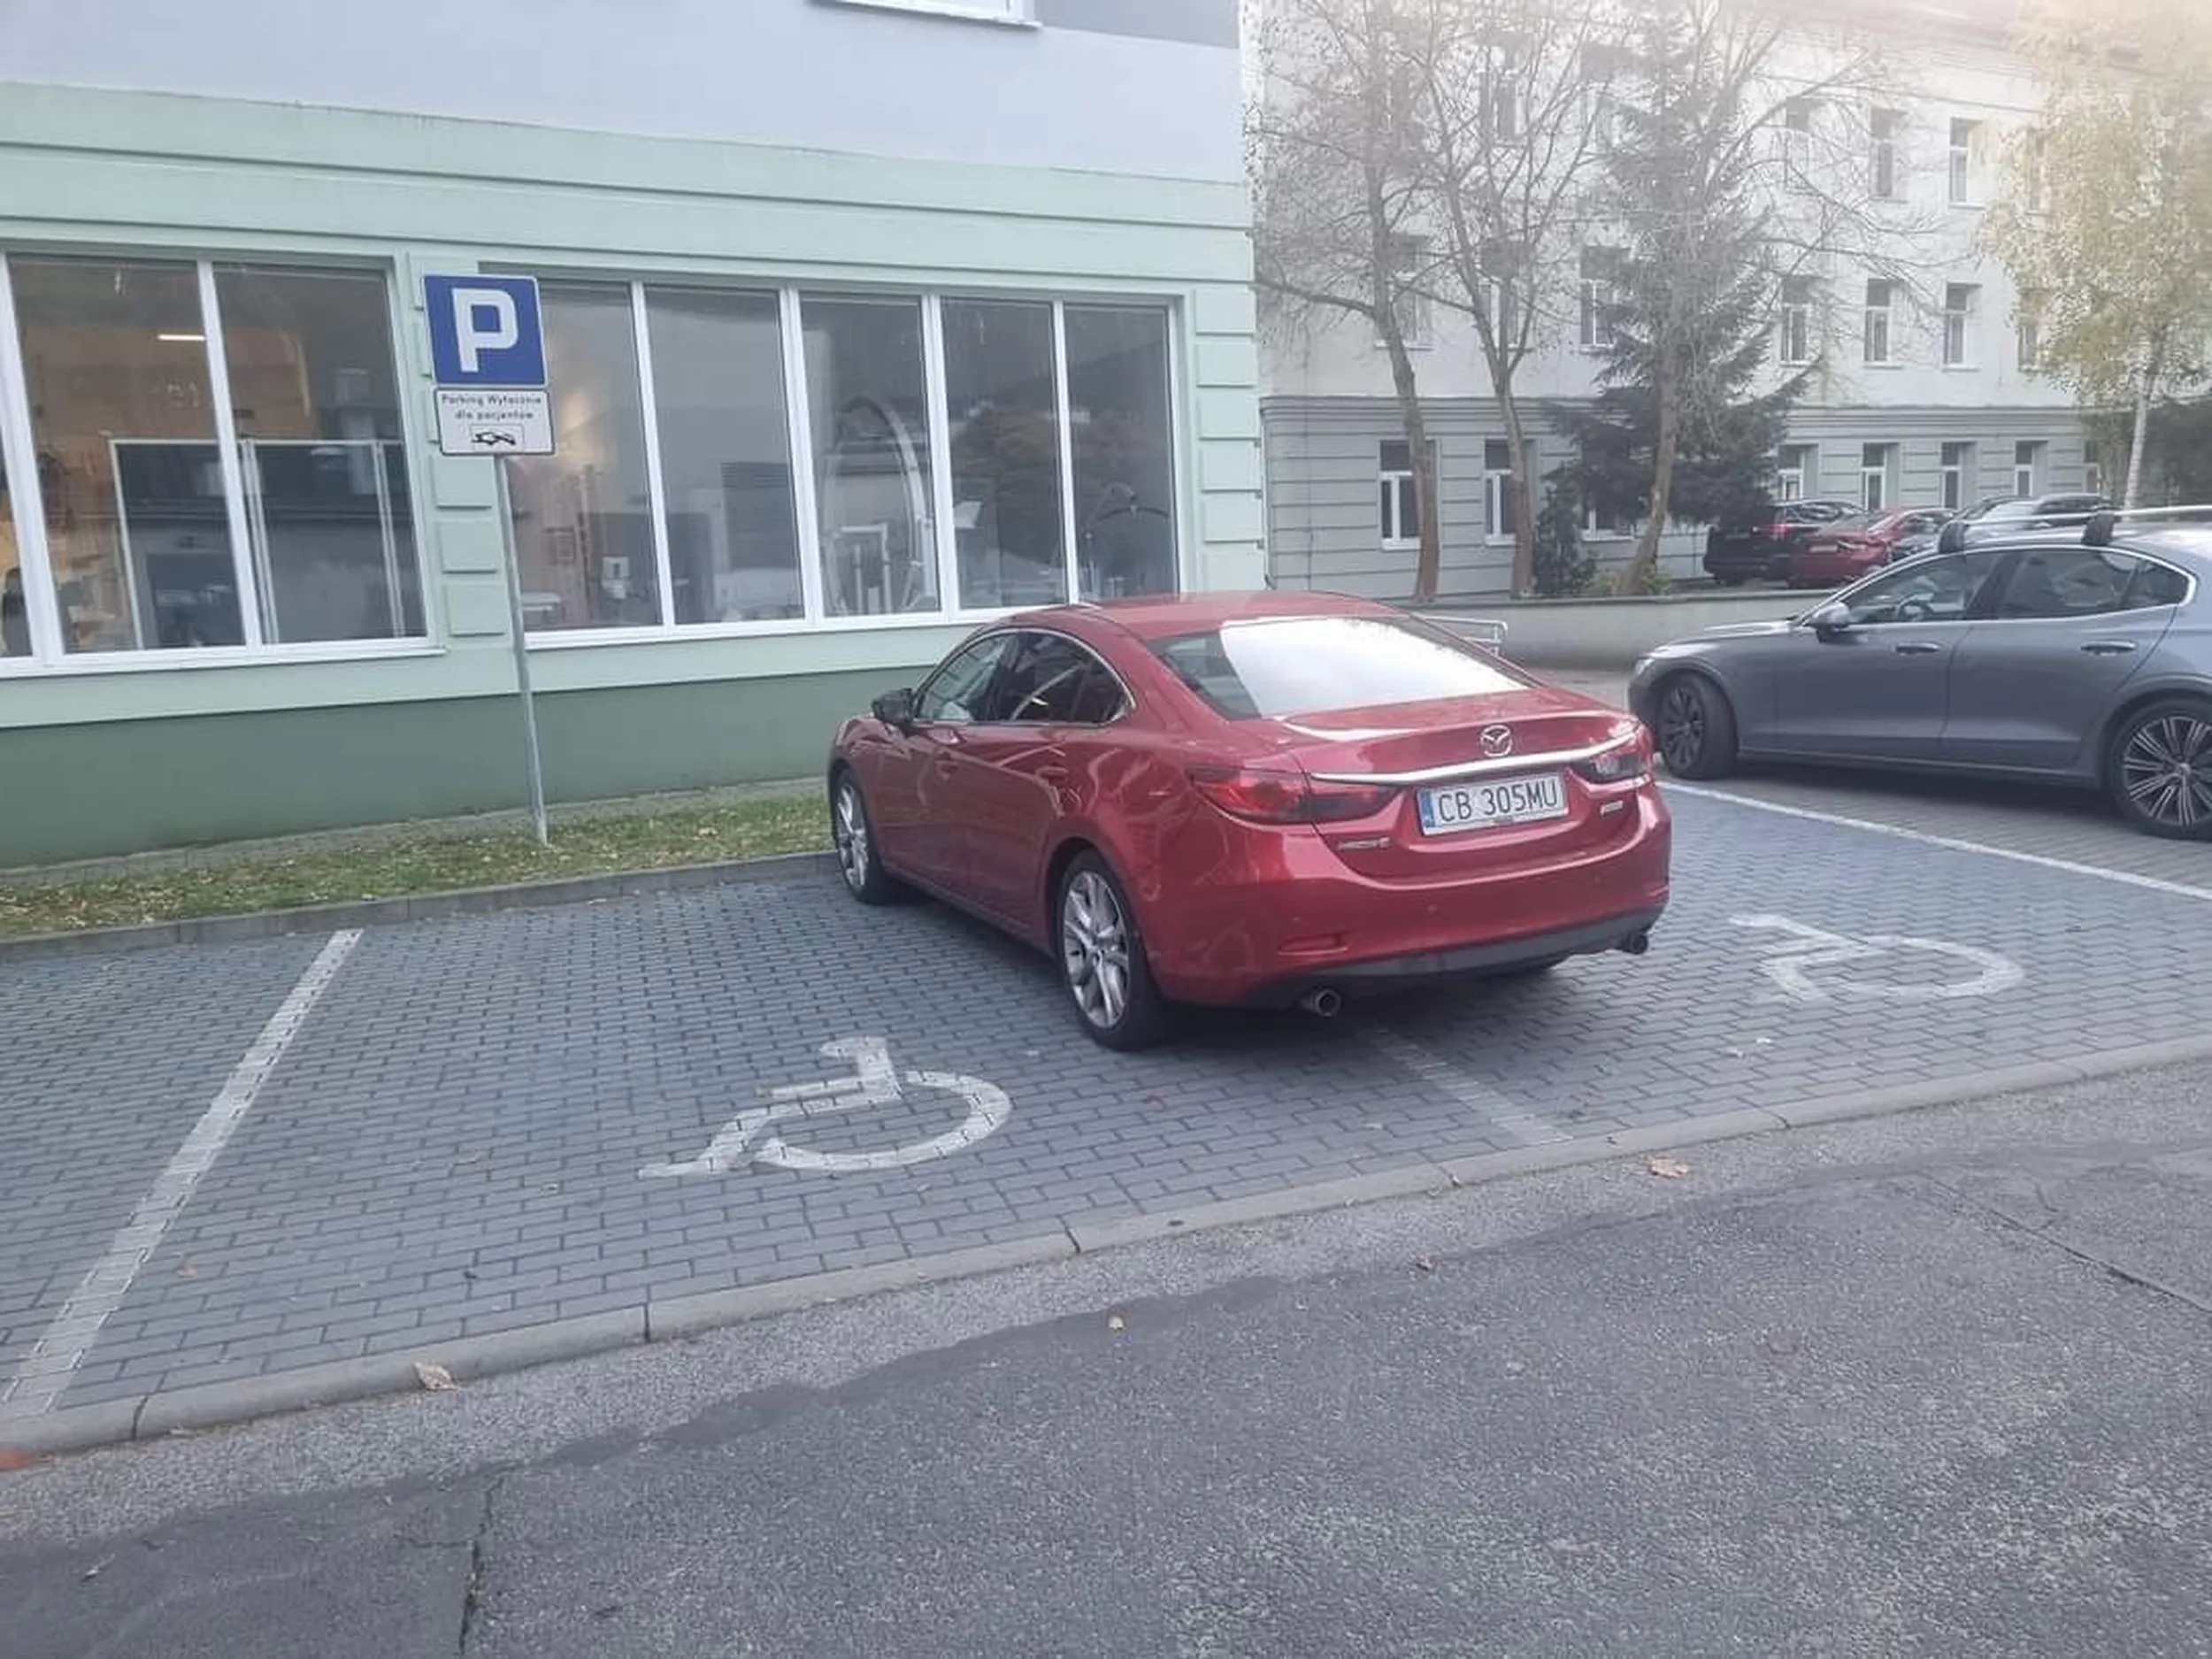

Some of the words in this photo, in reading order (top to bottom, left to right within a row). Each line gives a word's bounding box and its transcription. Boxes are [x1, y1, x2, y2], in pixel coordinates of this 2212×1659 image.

[452, 288, 518, 372] P
[442, 393, 484, 406] Parking
[1439, 792, 1472, 822] CB
[1480, 780, 1558, 816] 305MU
